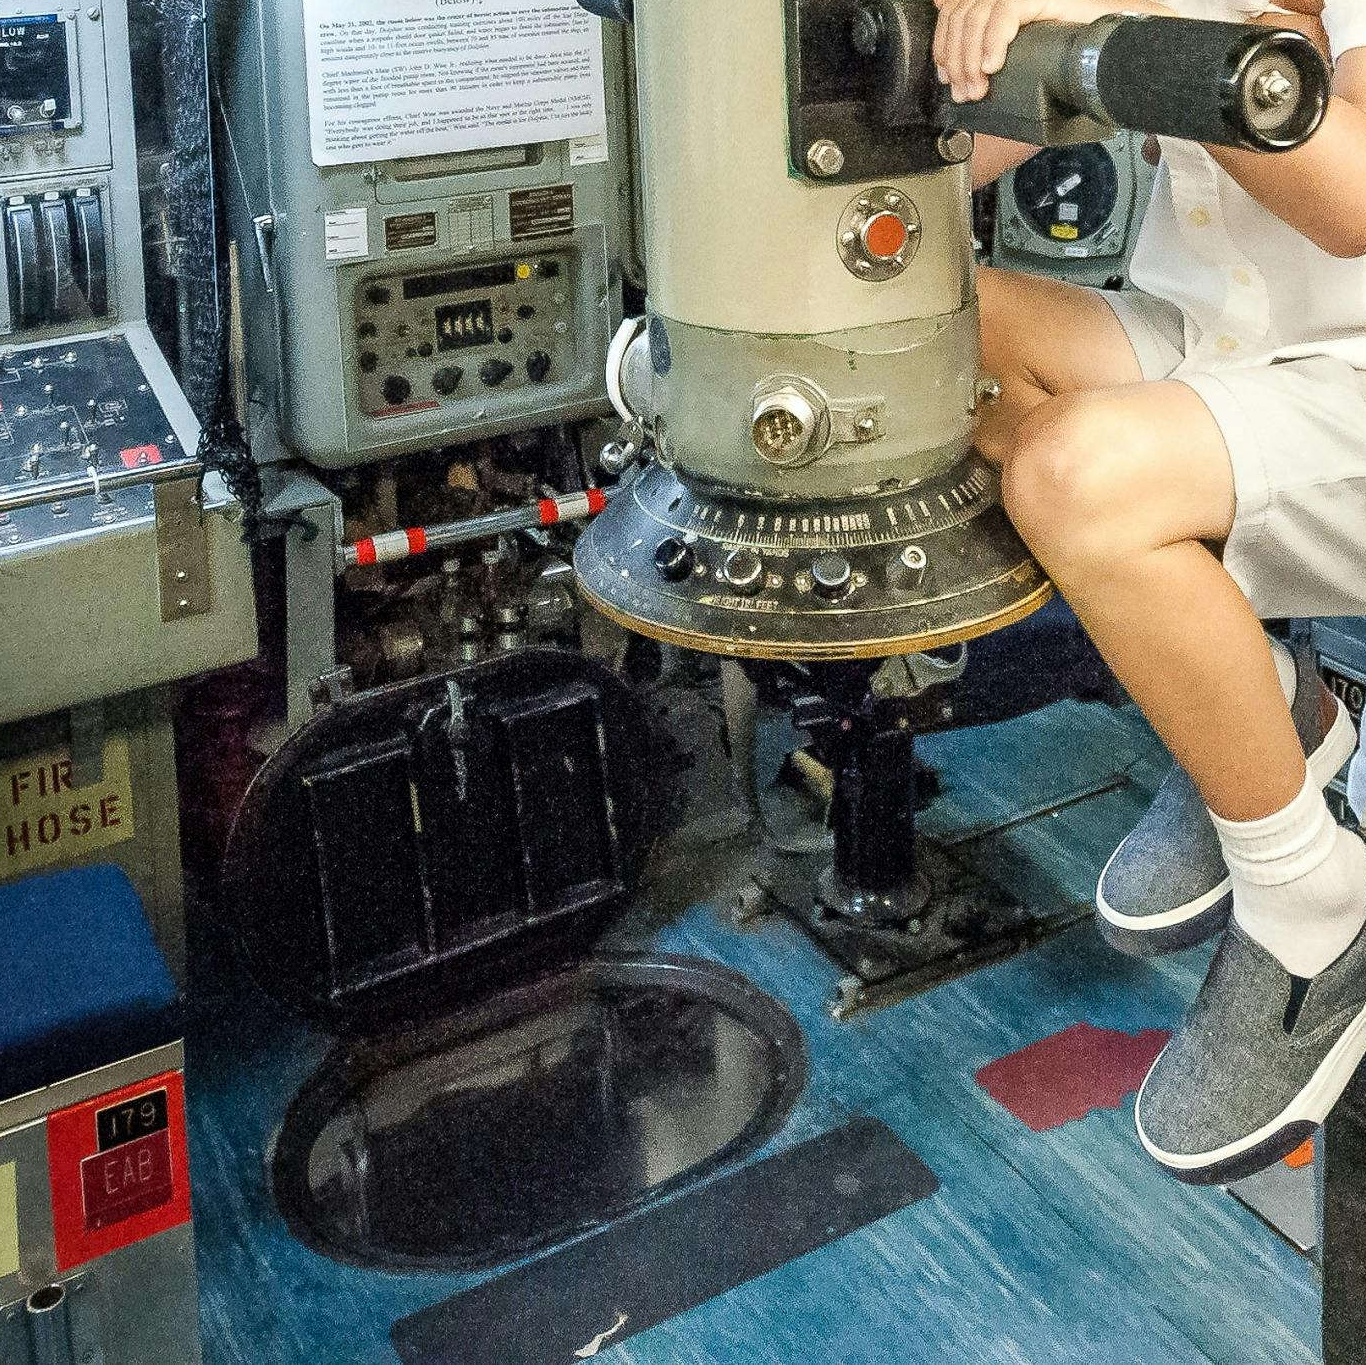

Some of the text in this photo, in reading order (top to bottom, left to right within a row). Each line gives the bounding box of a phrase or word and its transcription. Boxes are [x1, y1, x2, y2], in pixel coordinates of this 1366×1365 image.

[756, 601, 779, 610] FEET
[11, 760, 75, 805] FIR
[6, 795, 122, 856] HOSE
[105, 1148, 154, 1195] EAB
